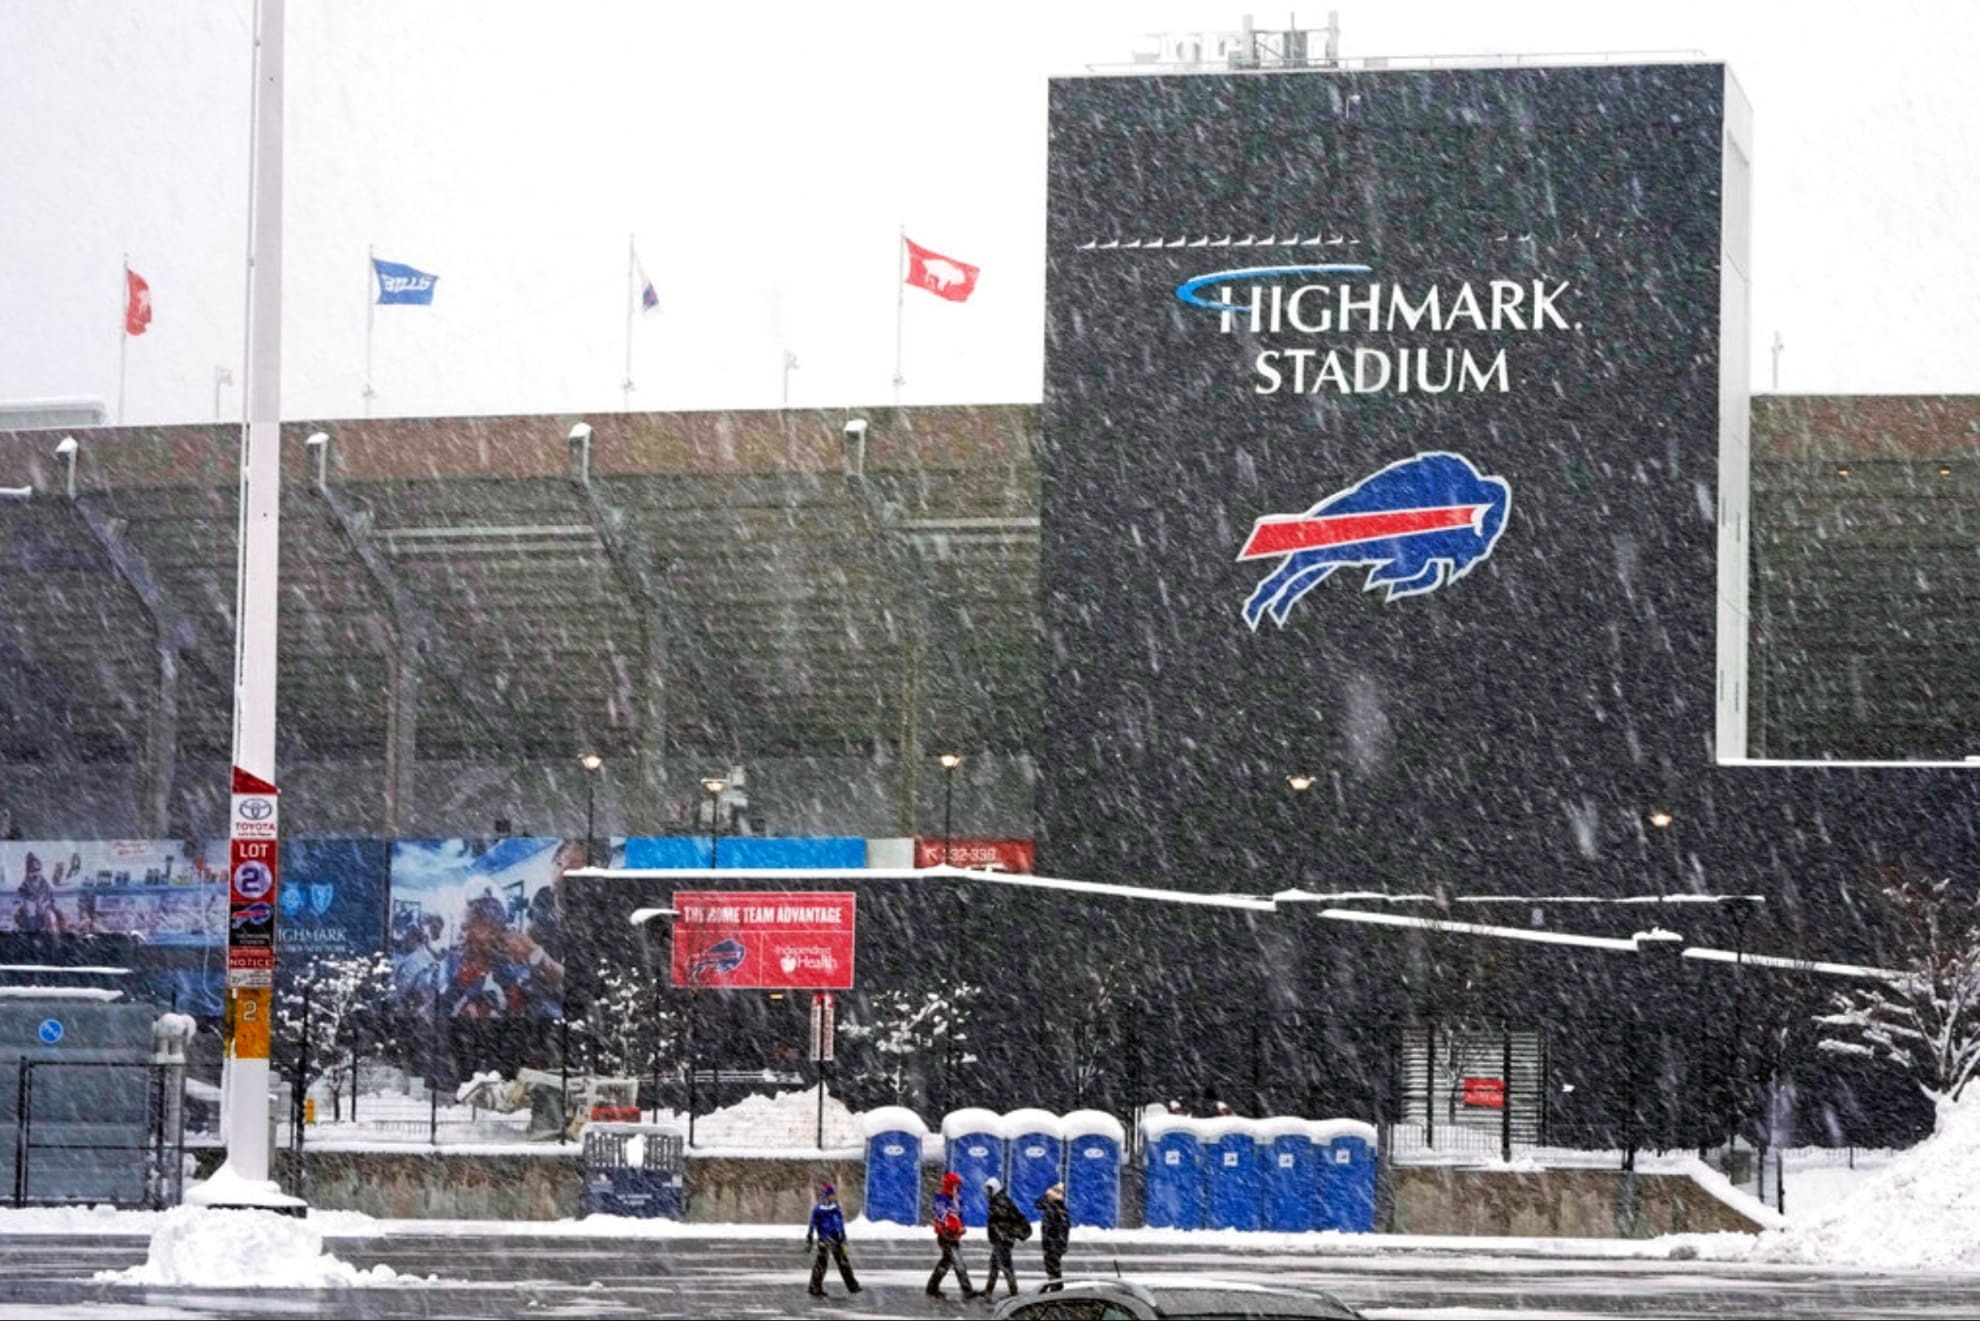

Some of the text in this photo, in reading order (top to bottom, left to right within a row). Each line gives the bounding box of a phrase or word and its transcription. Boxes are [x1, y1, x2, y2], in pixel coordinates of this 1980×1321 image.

[1255, 347, 1510, 394] STADIUM
[235, 822, 276, 831] TOYOTA
[239, 843, 270, 858] LOT
[241, 867, 260, 893] 2
[744, 907, 774, 923] TEAM
[776, 907, 842, 923] ADVANTAGE
[278, 928, 347, 941] IGHMARK
[230, 958, 272, 967] NOTICE
[243, 1001, 257, 1022] 2
